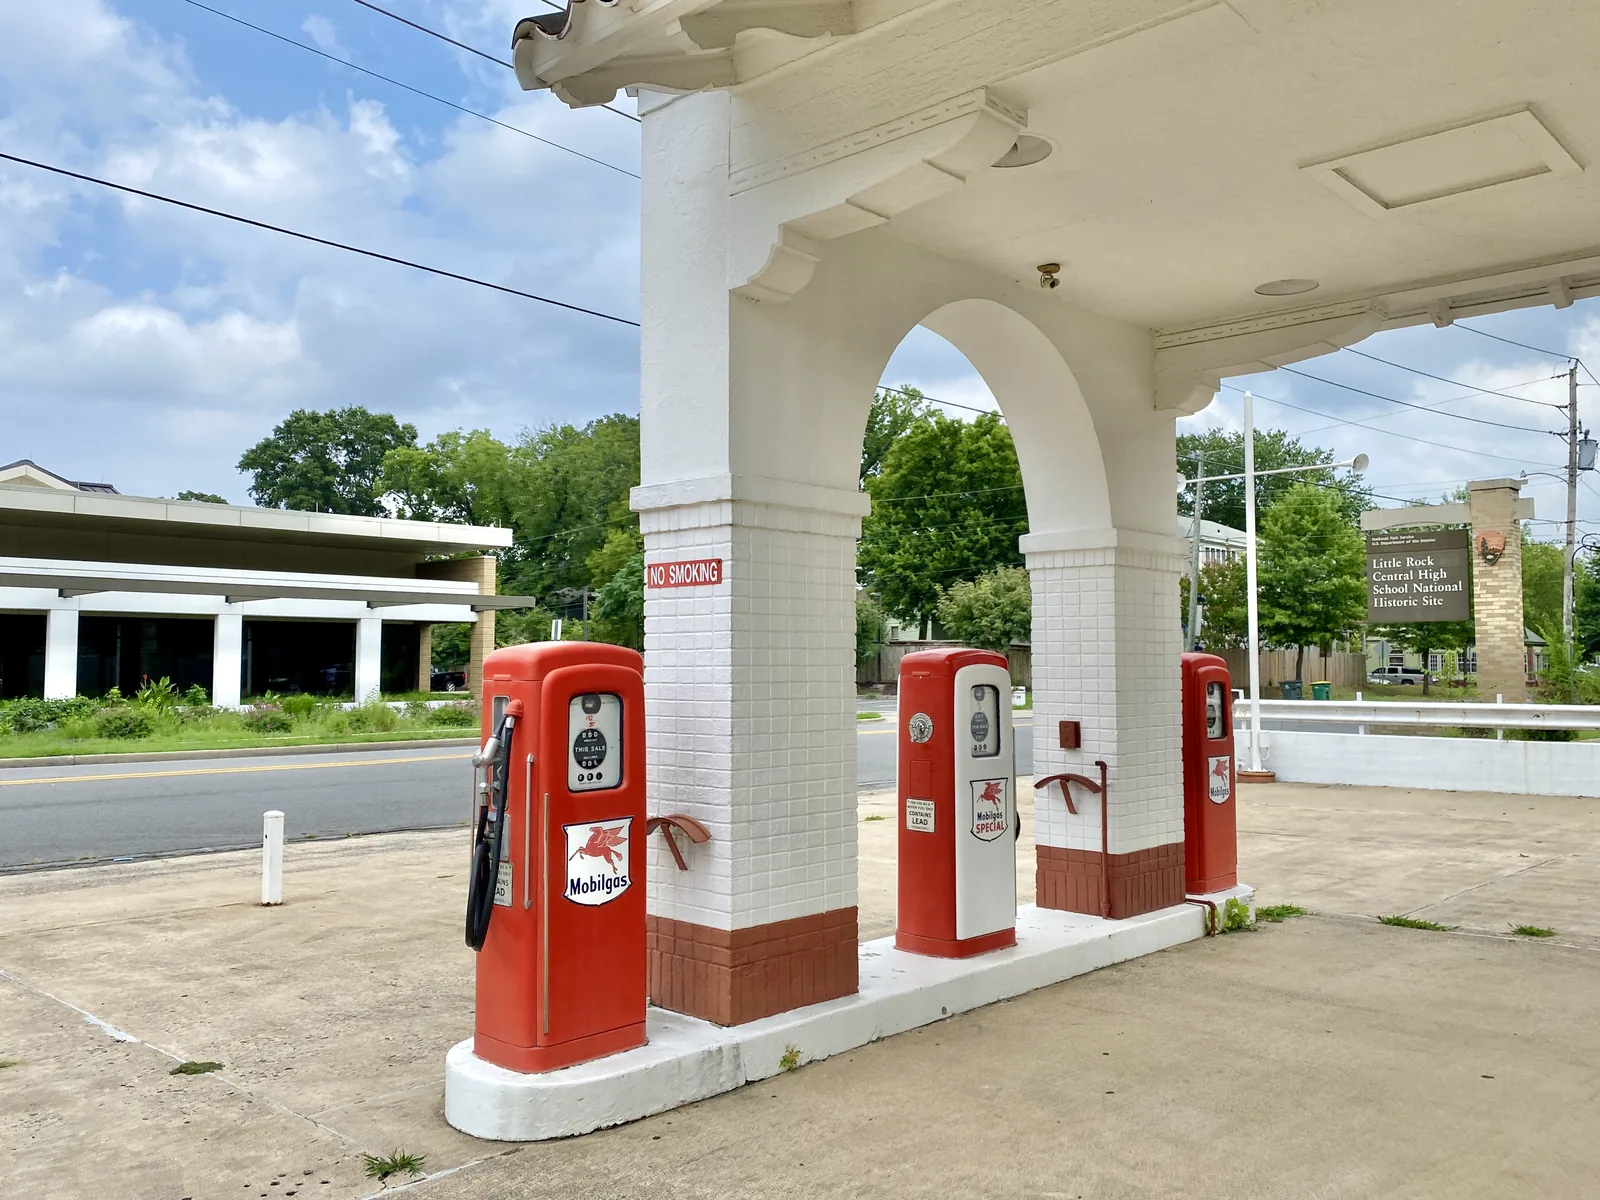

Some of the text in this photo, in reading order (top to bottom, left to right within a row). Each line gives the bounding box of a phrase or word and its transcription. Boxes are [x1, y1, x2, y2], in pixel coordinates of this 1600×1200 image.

[1372, 556, 1435, 569] Little Rock
[650, 562, 718, 586] NO SMOKING
[1372, 568, 1447, 582] Central High
[1372, 581, 1463, 595] School National
[1374, 595, 1444, 608] Historic Site
[1211, 787, 1229, 798] Mobilgas
[977, 811, 1003, 821] Mobilgas
[976, 821, 1004, 834] SPECIAL
[570, 874, 628, 895] Mobilgas
[495, 888, 505, 896] AD
